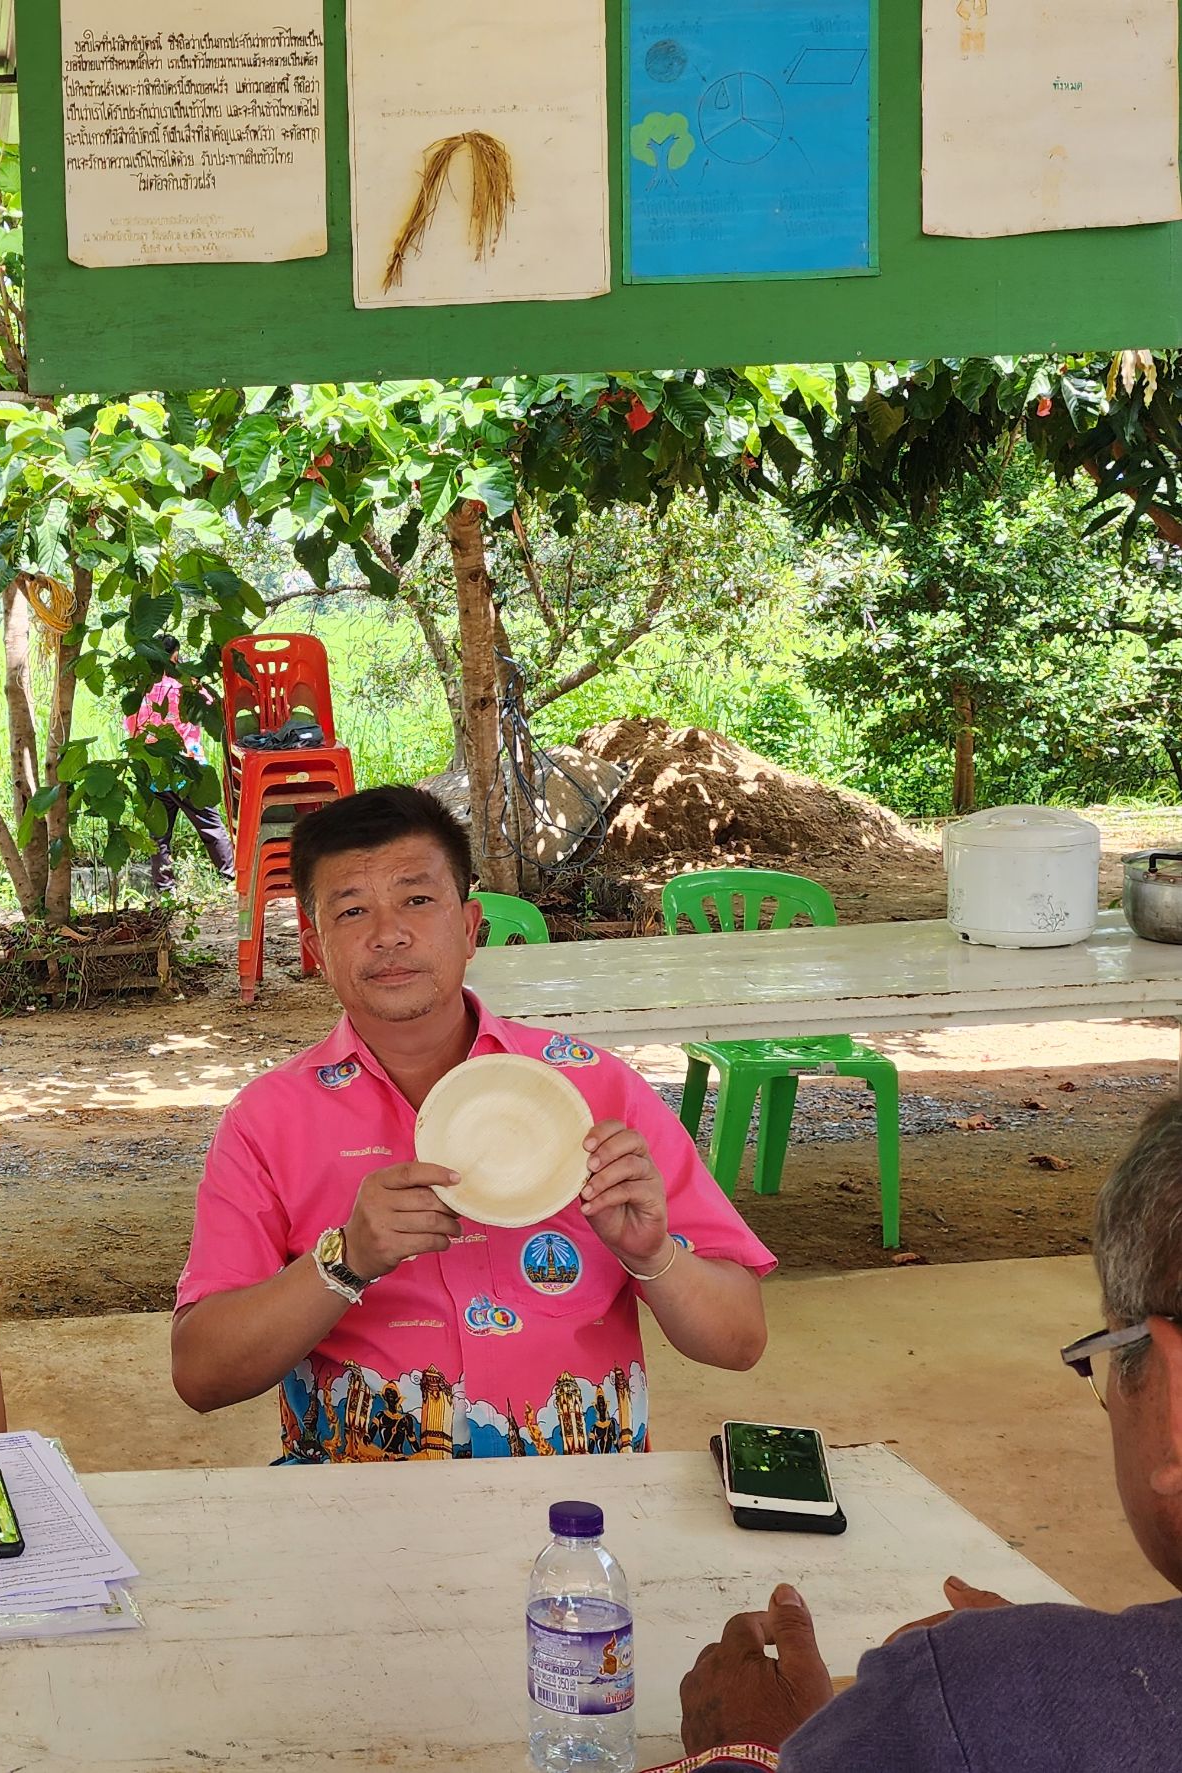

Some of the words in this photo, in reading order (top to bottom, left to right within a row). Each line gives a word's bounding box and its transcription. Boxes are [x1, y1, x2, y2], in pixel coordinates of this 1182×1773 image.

[1052, 75, 1083, 91] ทั้งหมด
[131, 169, 217, 192] ไม่ต้องกินข้าวฝรั่ง
